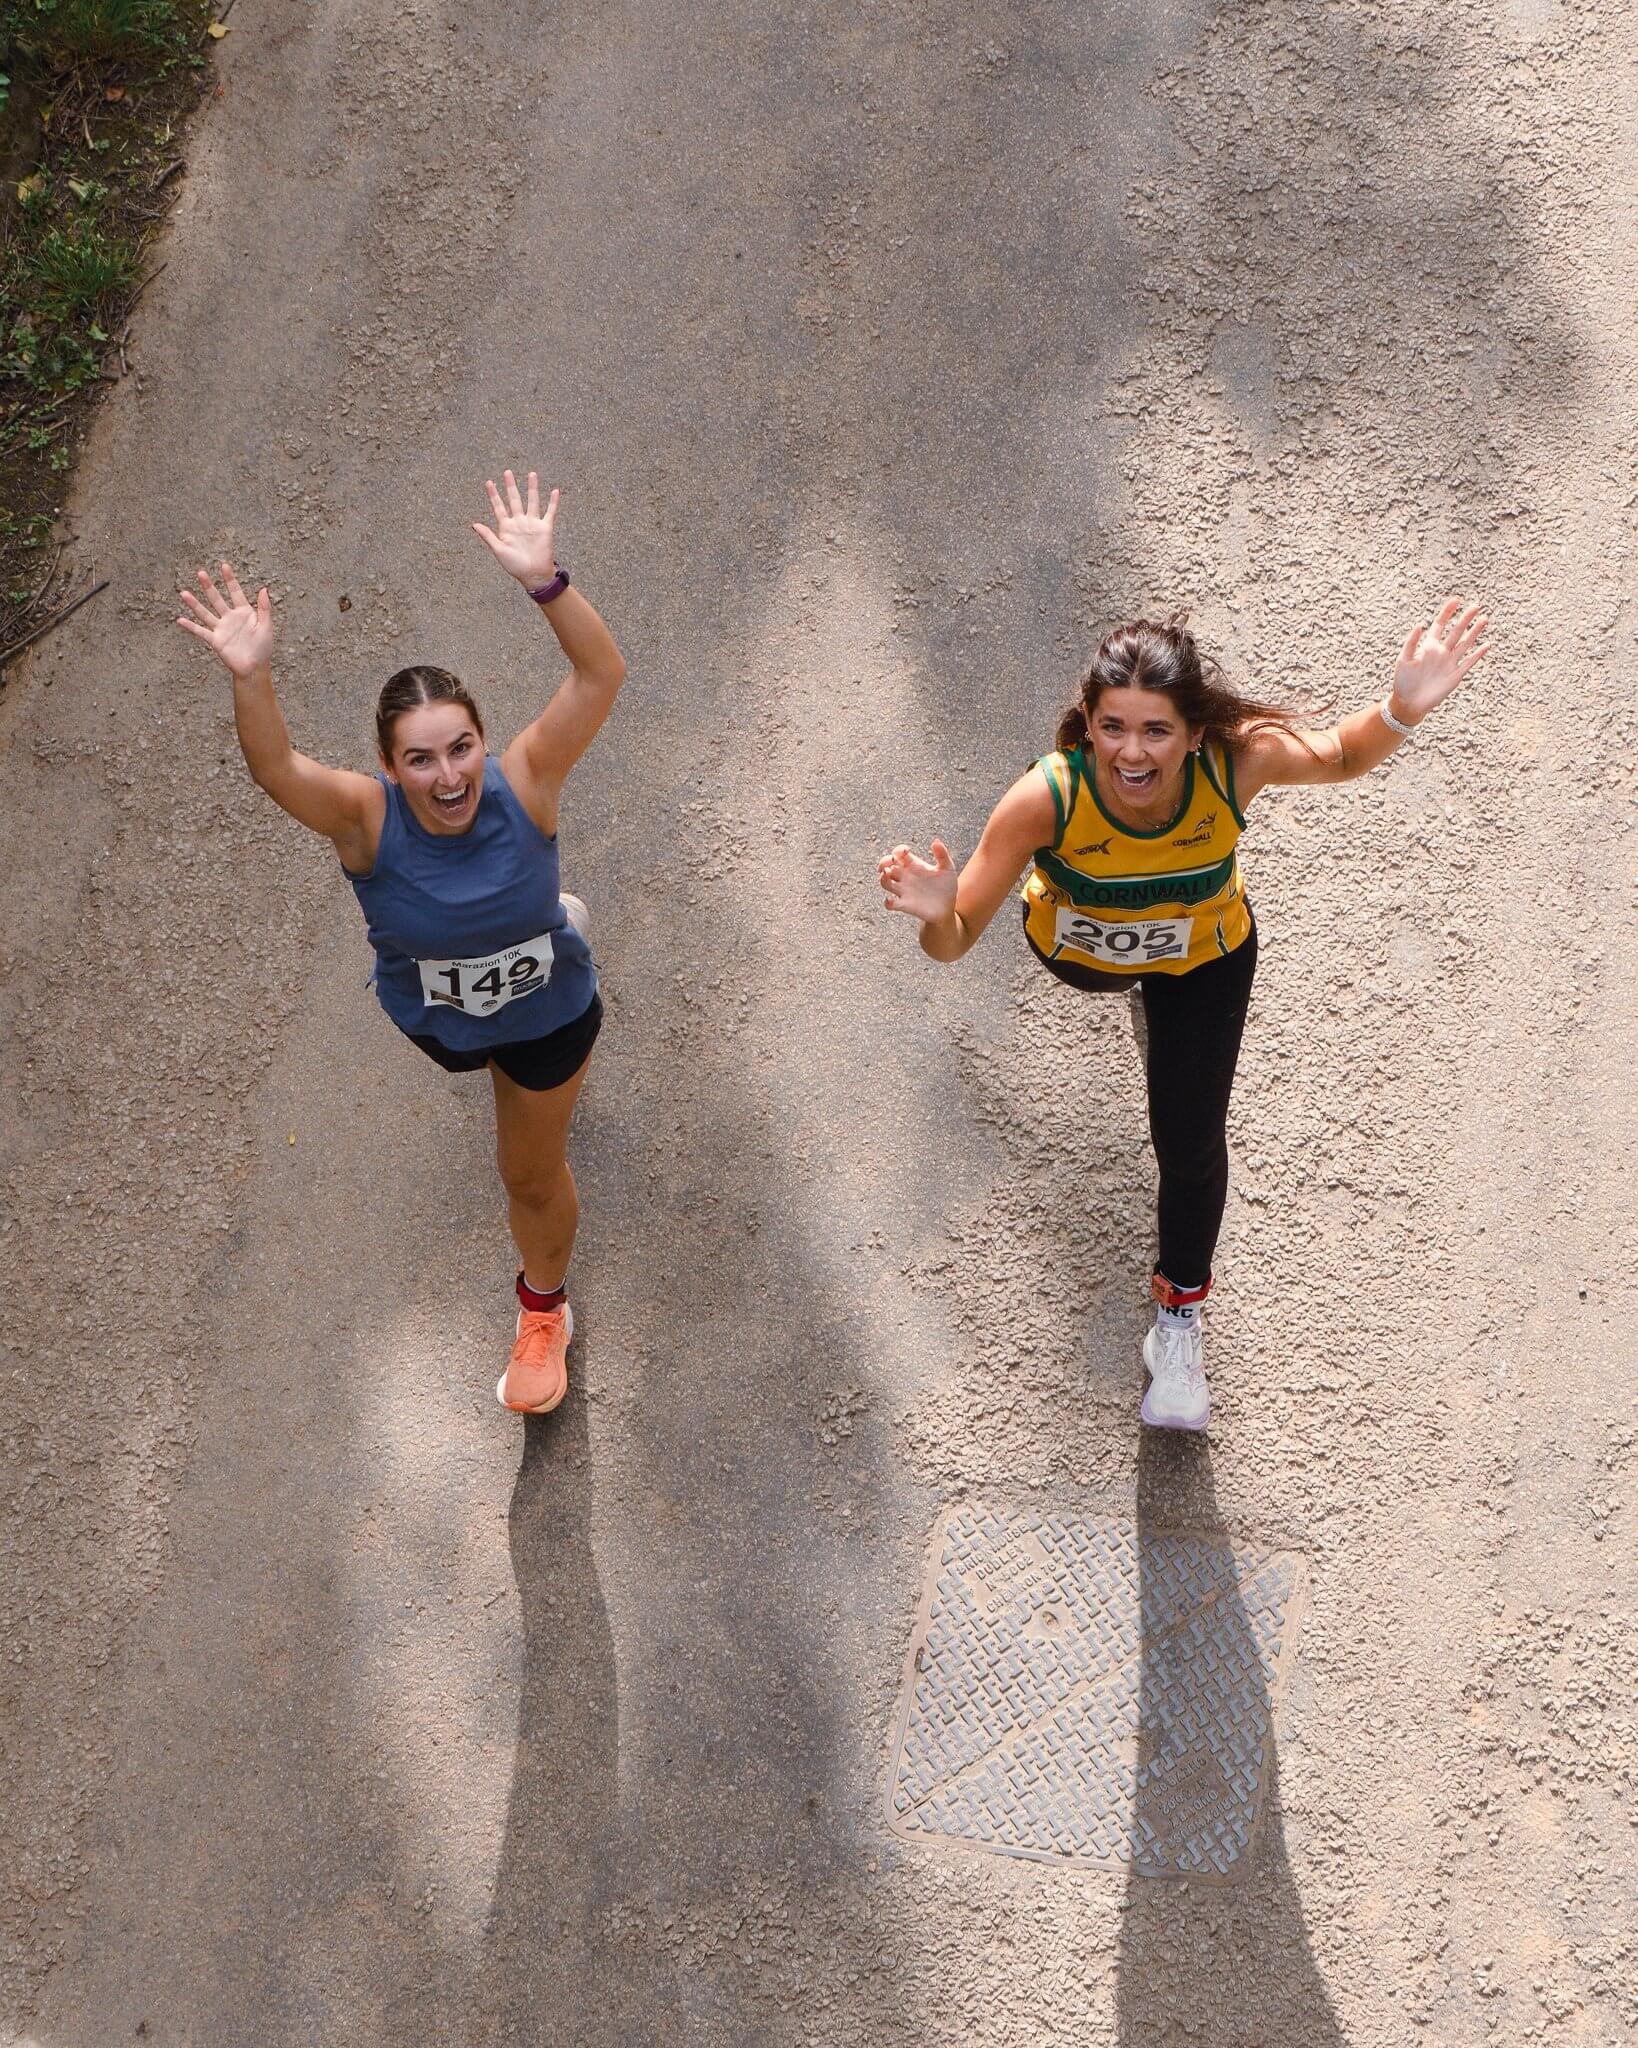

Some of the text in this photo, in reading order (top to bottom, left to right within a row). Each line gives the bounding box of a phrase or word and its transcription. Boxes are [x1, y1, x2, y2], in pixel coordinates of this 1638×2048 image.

[1172, 832, 1212, 847] CORNWALL
[1080, 876, 1216, 904] CORNWALL
[1070, 920, 1176, 952] 205
[451, 949, 522, 969] Marazion 10K
[439, 956, 539, 997] 149
[976, 1545, 1024, 1580] DUDLEY
